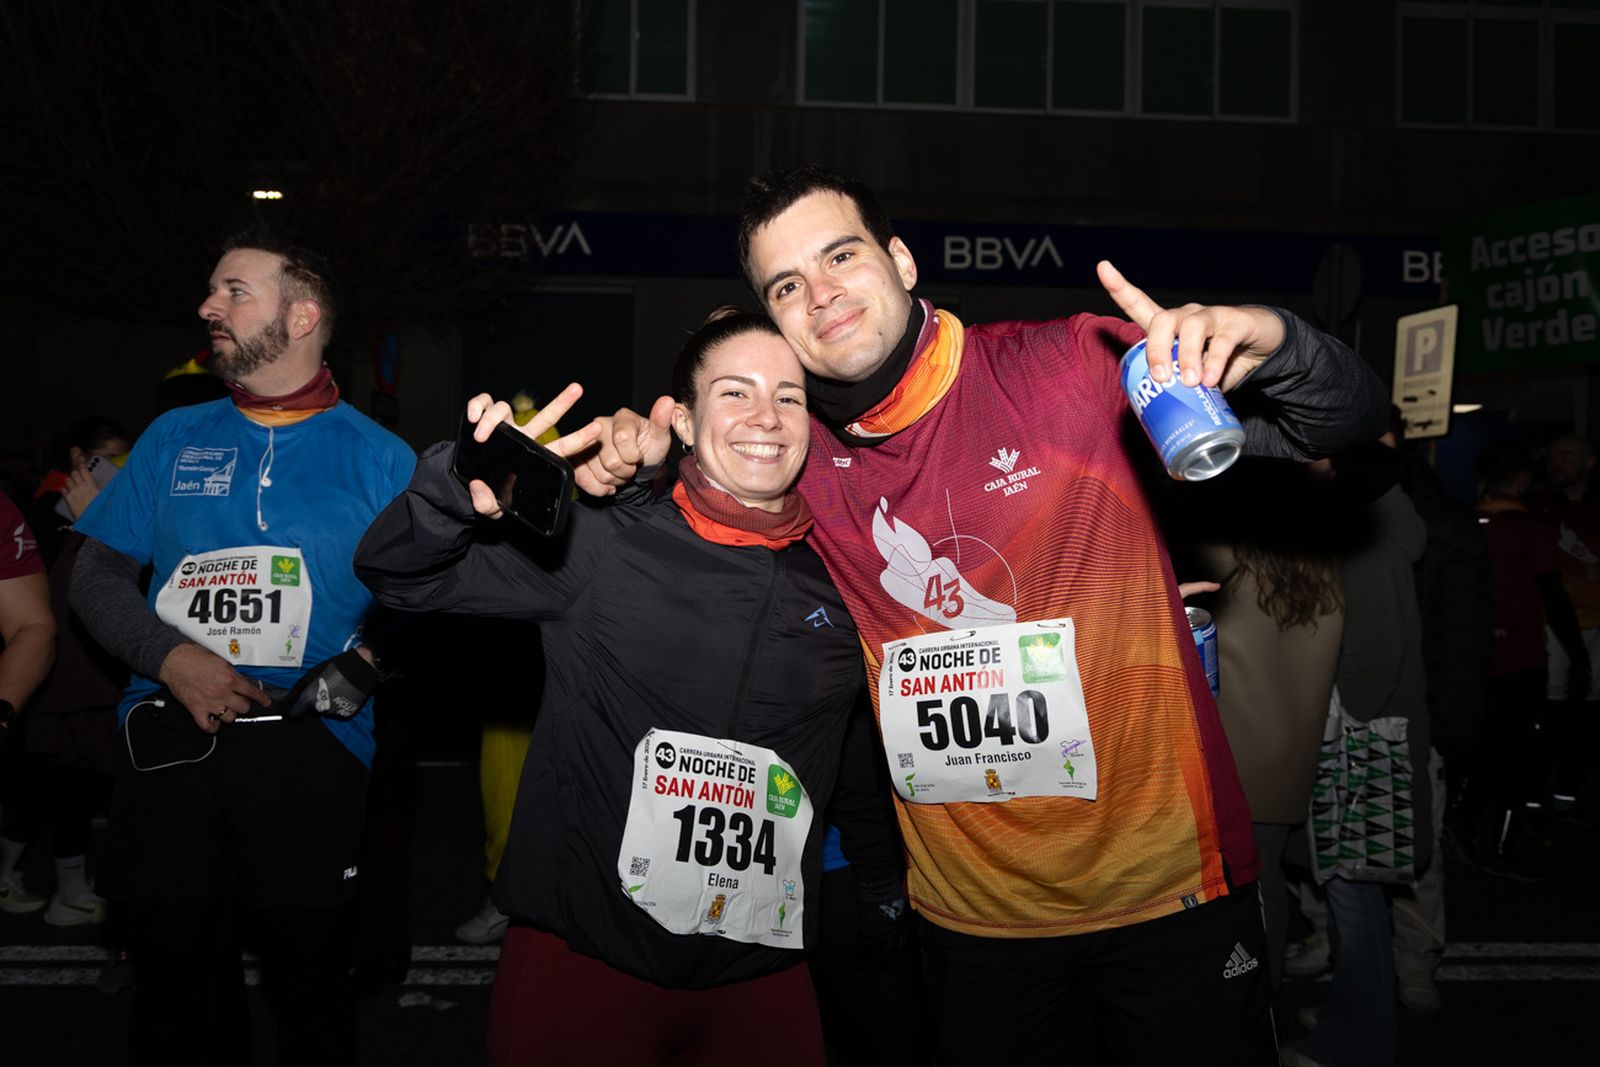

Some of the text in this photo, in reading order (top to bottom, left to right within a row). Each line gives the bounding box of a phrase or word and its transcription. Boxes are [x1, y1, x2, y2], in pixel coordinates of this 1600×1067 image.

[468, 221, 592, 257] BBVA
[944, 234, 1064, 270] BBVA
[1470, 223, 1600, 272] Acceso
[1485, 262, 1591, 313] cajón
[1480, 307, 1598, 352] Verde
[1413, 326, 1437, 371] P
[175, 480, 200, 490] Jaén
[984, 466, 1040, 493] CAJA RURAL
[1003, 481, 1028, 497] JAÉN
[178, 575, 206, 589] SAN
[208, 571, 257, 586] ANTÓN
[198, 560, 258, 574] NOCHE DE
[187, 588, 282, 624] 4651
[924, 574, 964, 619] 43
[207, 626, 261, 636] José Ramón
[920, 647, 1001, 671] NOCHE DE
[900, 665, 1004, 697] SAN ANTÓN
[916, 689, 1049, 751] 5040
[656, 747, 674, 763] 43
[679, 755, 756, 784] NOCHE DE
[945, 751, 1031, 766] Juan Francisco
[654, 775, 756, 809] SAN ANTÓN
[673, 804, 777, 875] 1334
[707, 872, 739, 889] Elena
[1223, 957, 1259, 979] adidas
